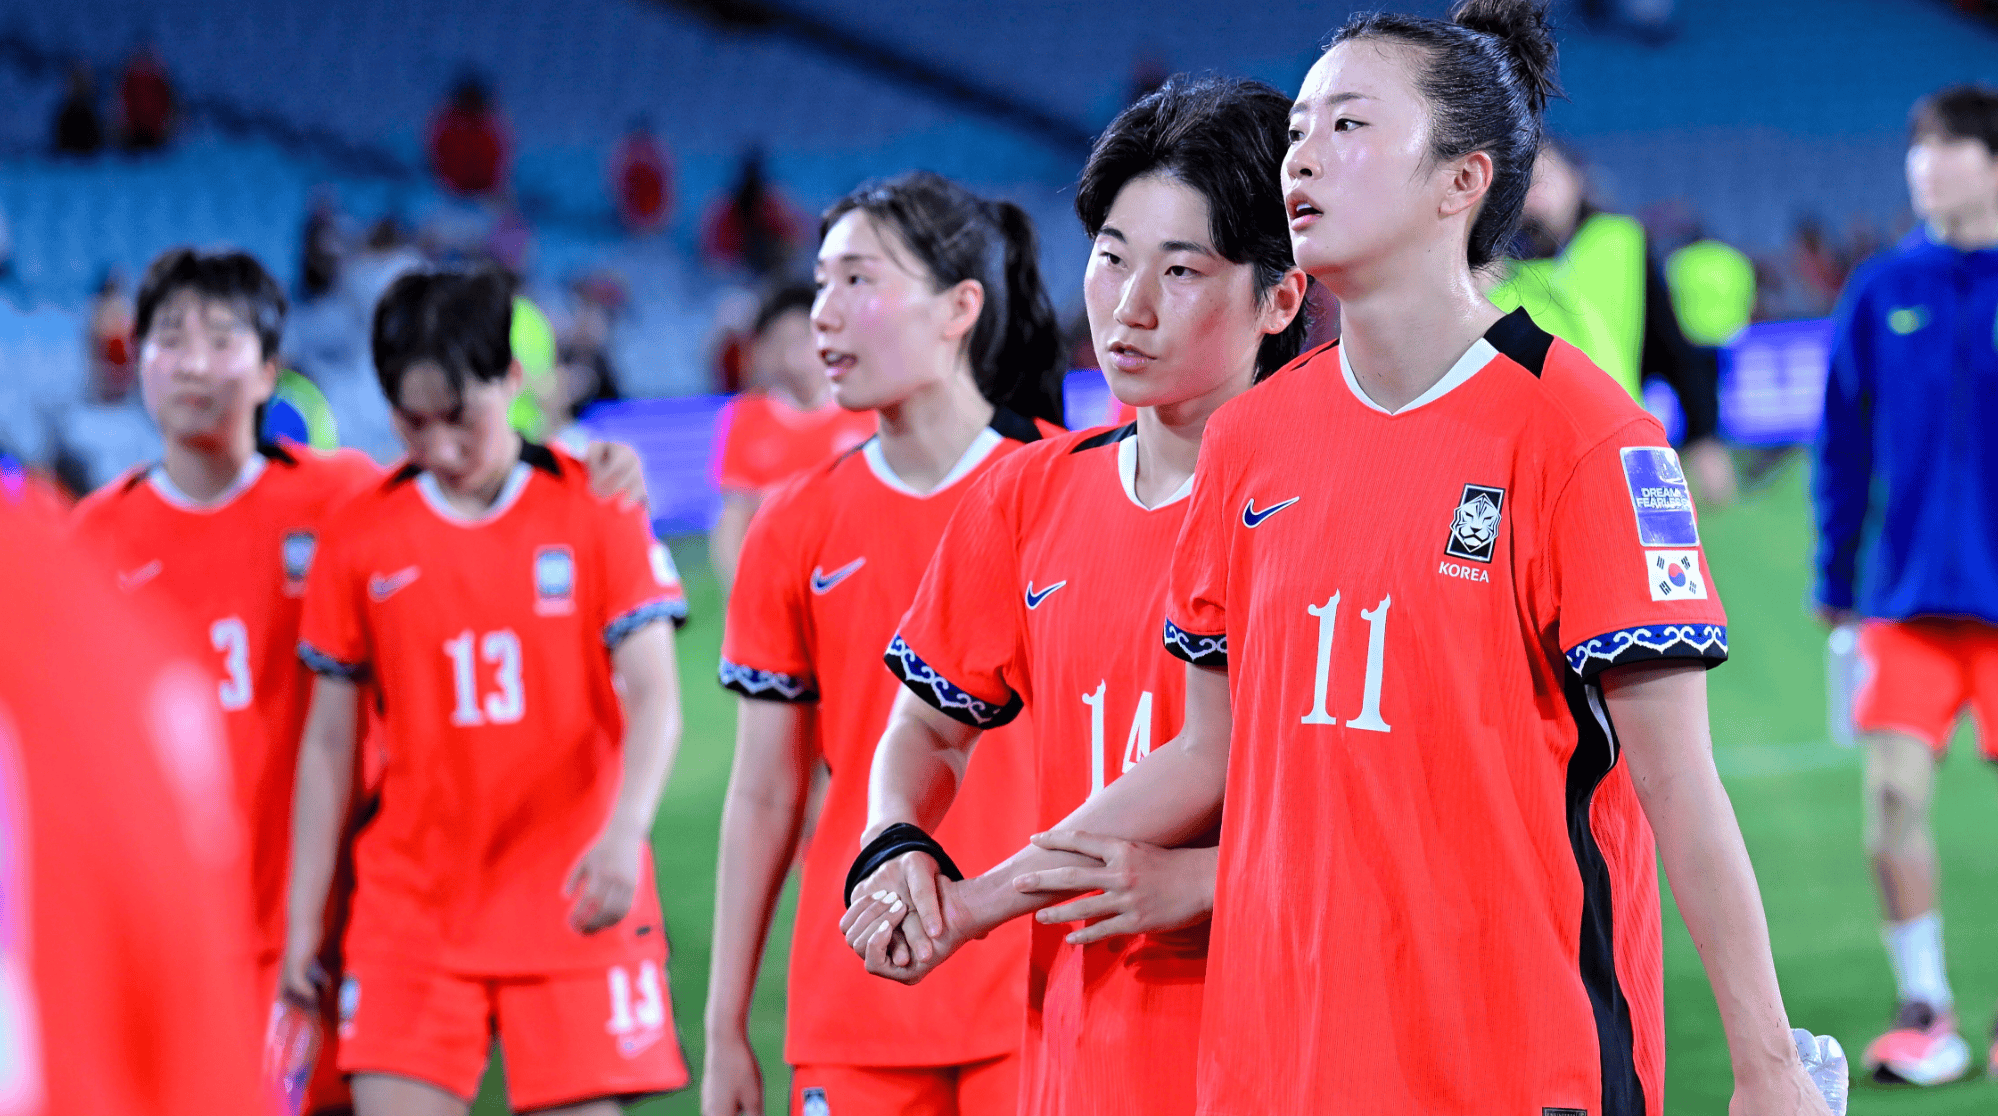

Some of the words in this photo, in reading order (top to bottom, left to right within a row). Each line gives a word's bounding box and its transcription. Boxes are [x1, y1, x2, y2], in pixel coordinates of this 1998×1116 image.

[1641, 487, 1681, 498] DREAM
[1438, 561, 1490, 583] KOREA
[209, 616, 254, 711] 3
[444, 628, 525, 726] 13
[1300, 587, 1392, 733] 11
[1081, 678, 1153, 802] 14
